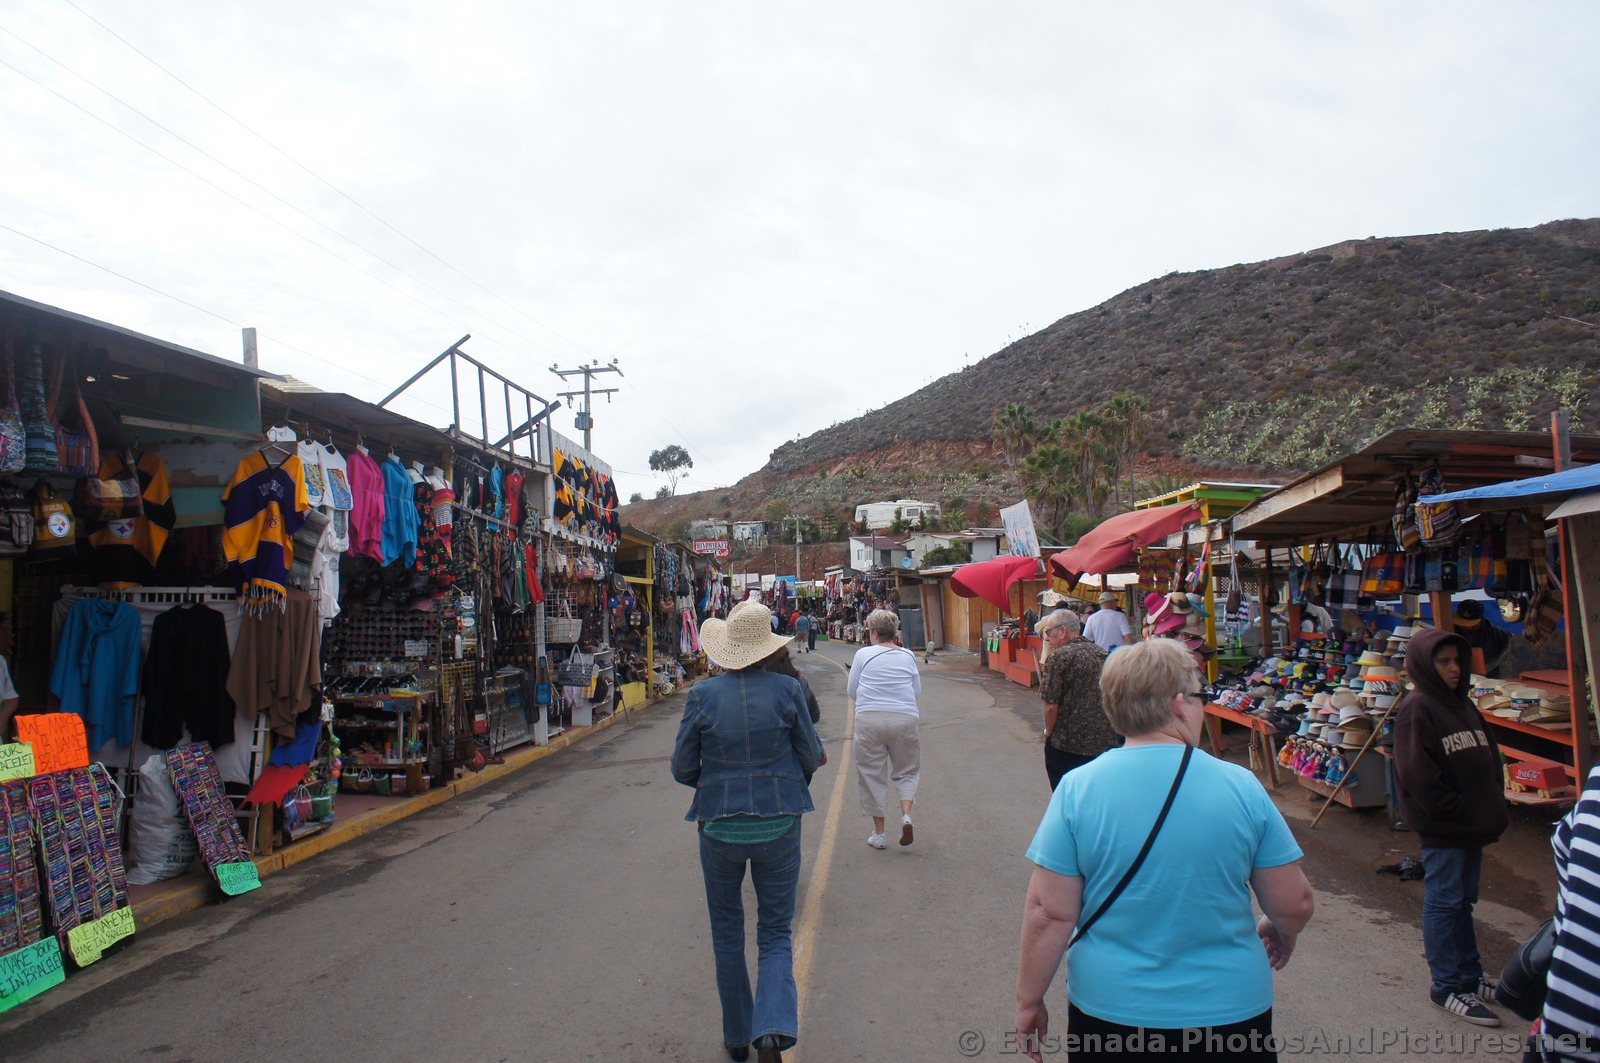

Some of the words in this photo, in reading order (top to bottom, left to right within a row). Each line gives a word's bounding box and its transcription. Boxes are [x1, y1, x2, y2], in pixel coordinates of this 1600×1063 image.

[20, 715, 47, 736] WE
[48, 714, 86, 735] MAKE
[54, 733, 87, 753] NAME
[1442, 730, 1477, 756] PISMO
[38, 748, 88, 772] BRACELET
[93, 912, 120, 936] MAKE
[31, 940, 60, 959] YOUR
[92, 933, 107, 949] IN
[6, 972, 24, 994] IN
